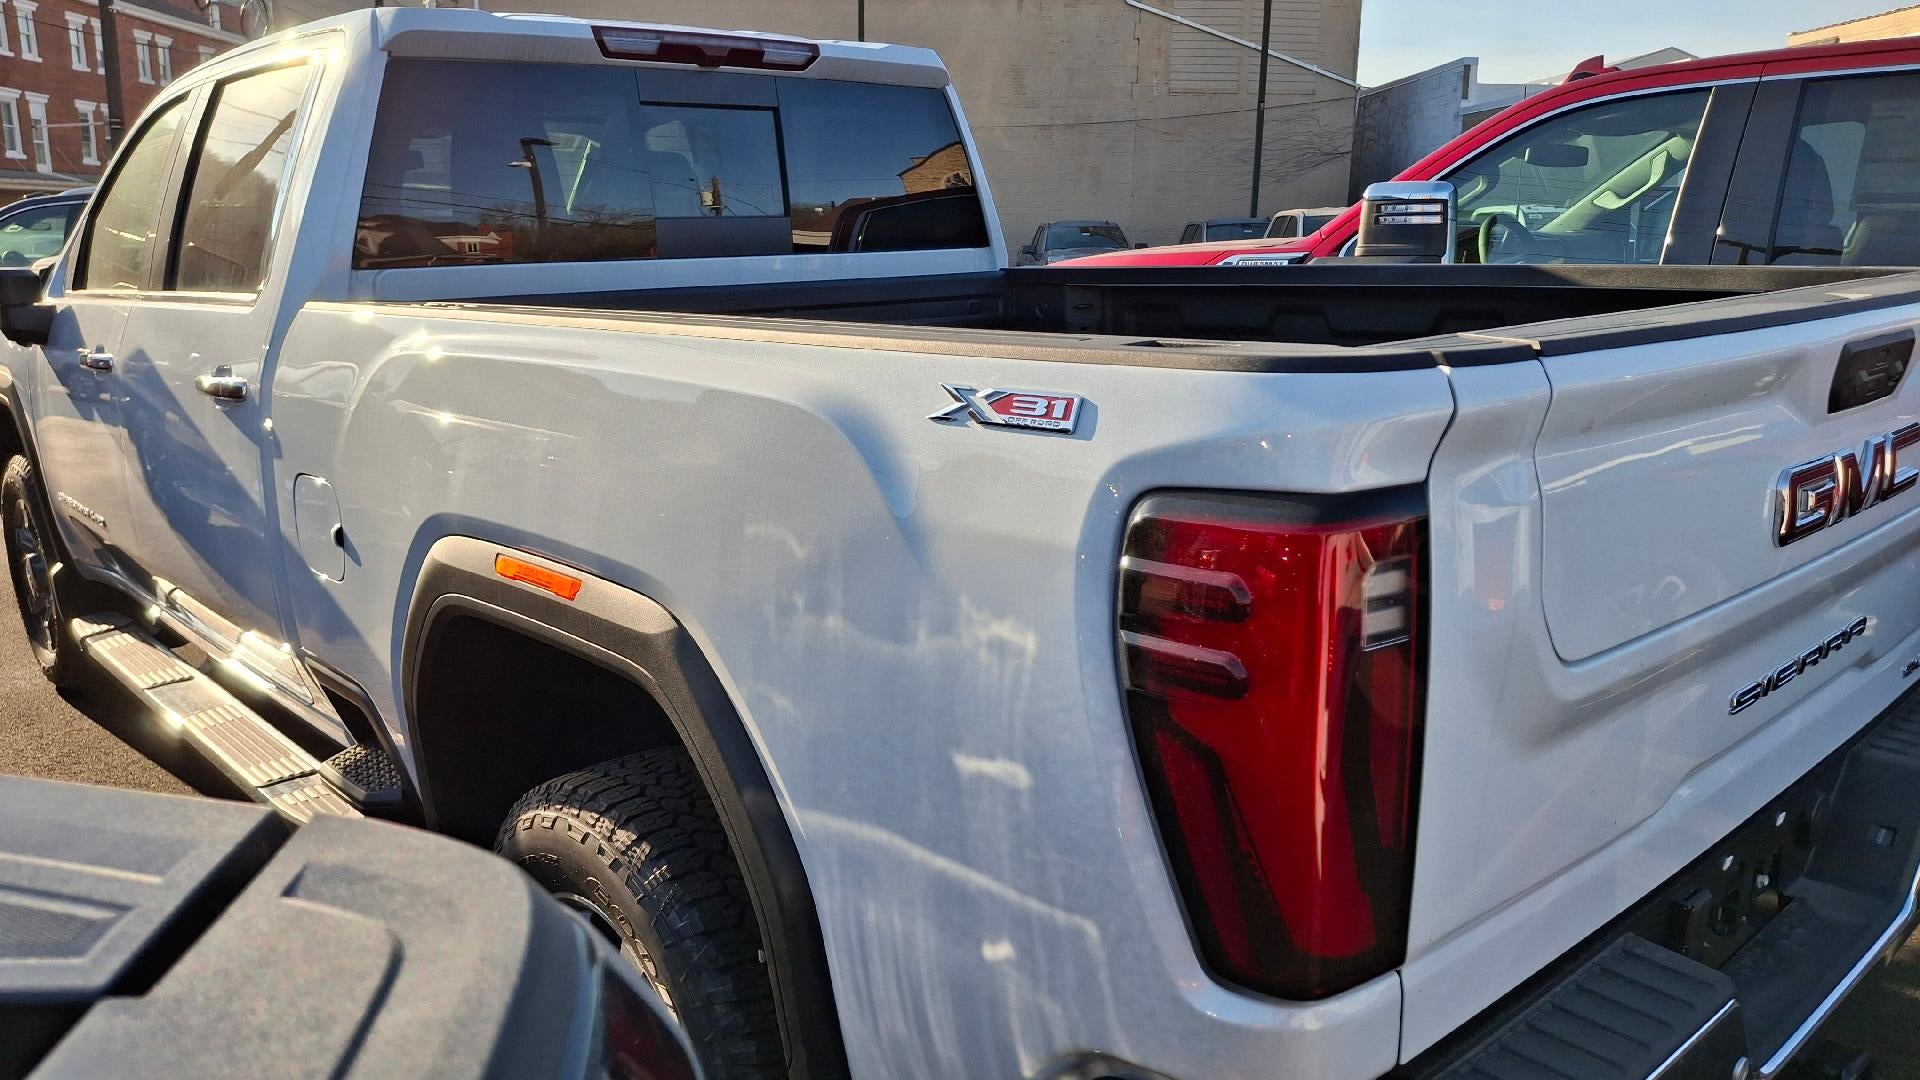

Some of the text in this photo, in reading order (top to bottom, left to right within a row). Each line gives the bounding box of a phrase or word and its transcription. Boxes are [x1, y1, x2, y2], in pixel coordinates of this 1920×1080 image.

[926, 383, 1068, 424] X31
[1007, 417, 1061, 428] OFF ROAD
[1768, 422, 1920, 547] GMC
[1728, 616, 1868, 715] SIERRA
